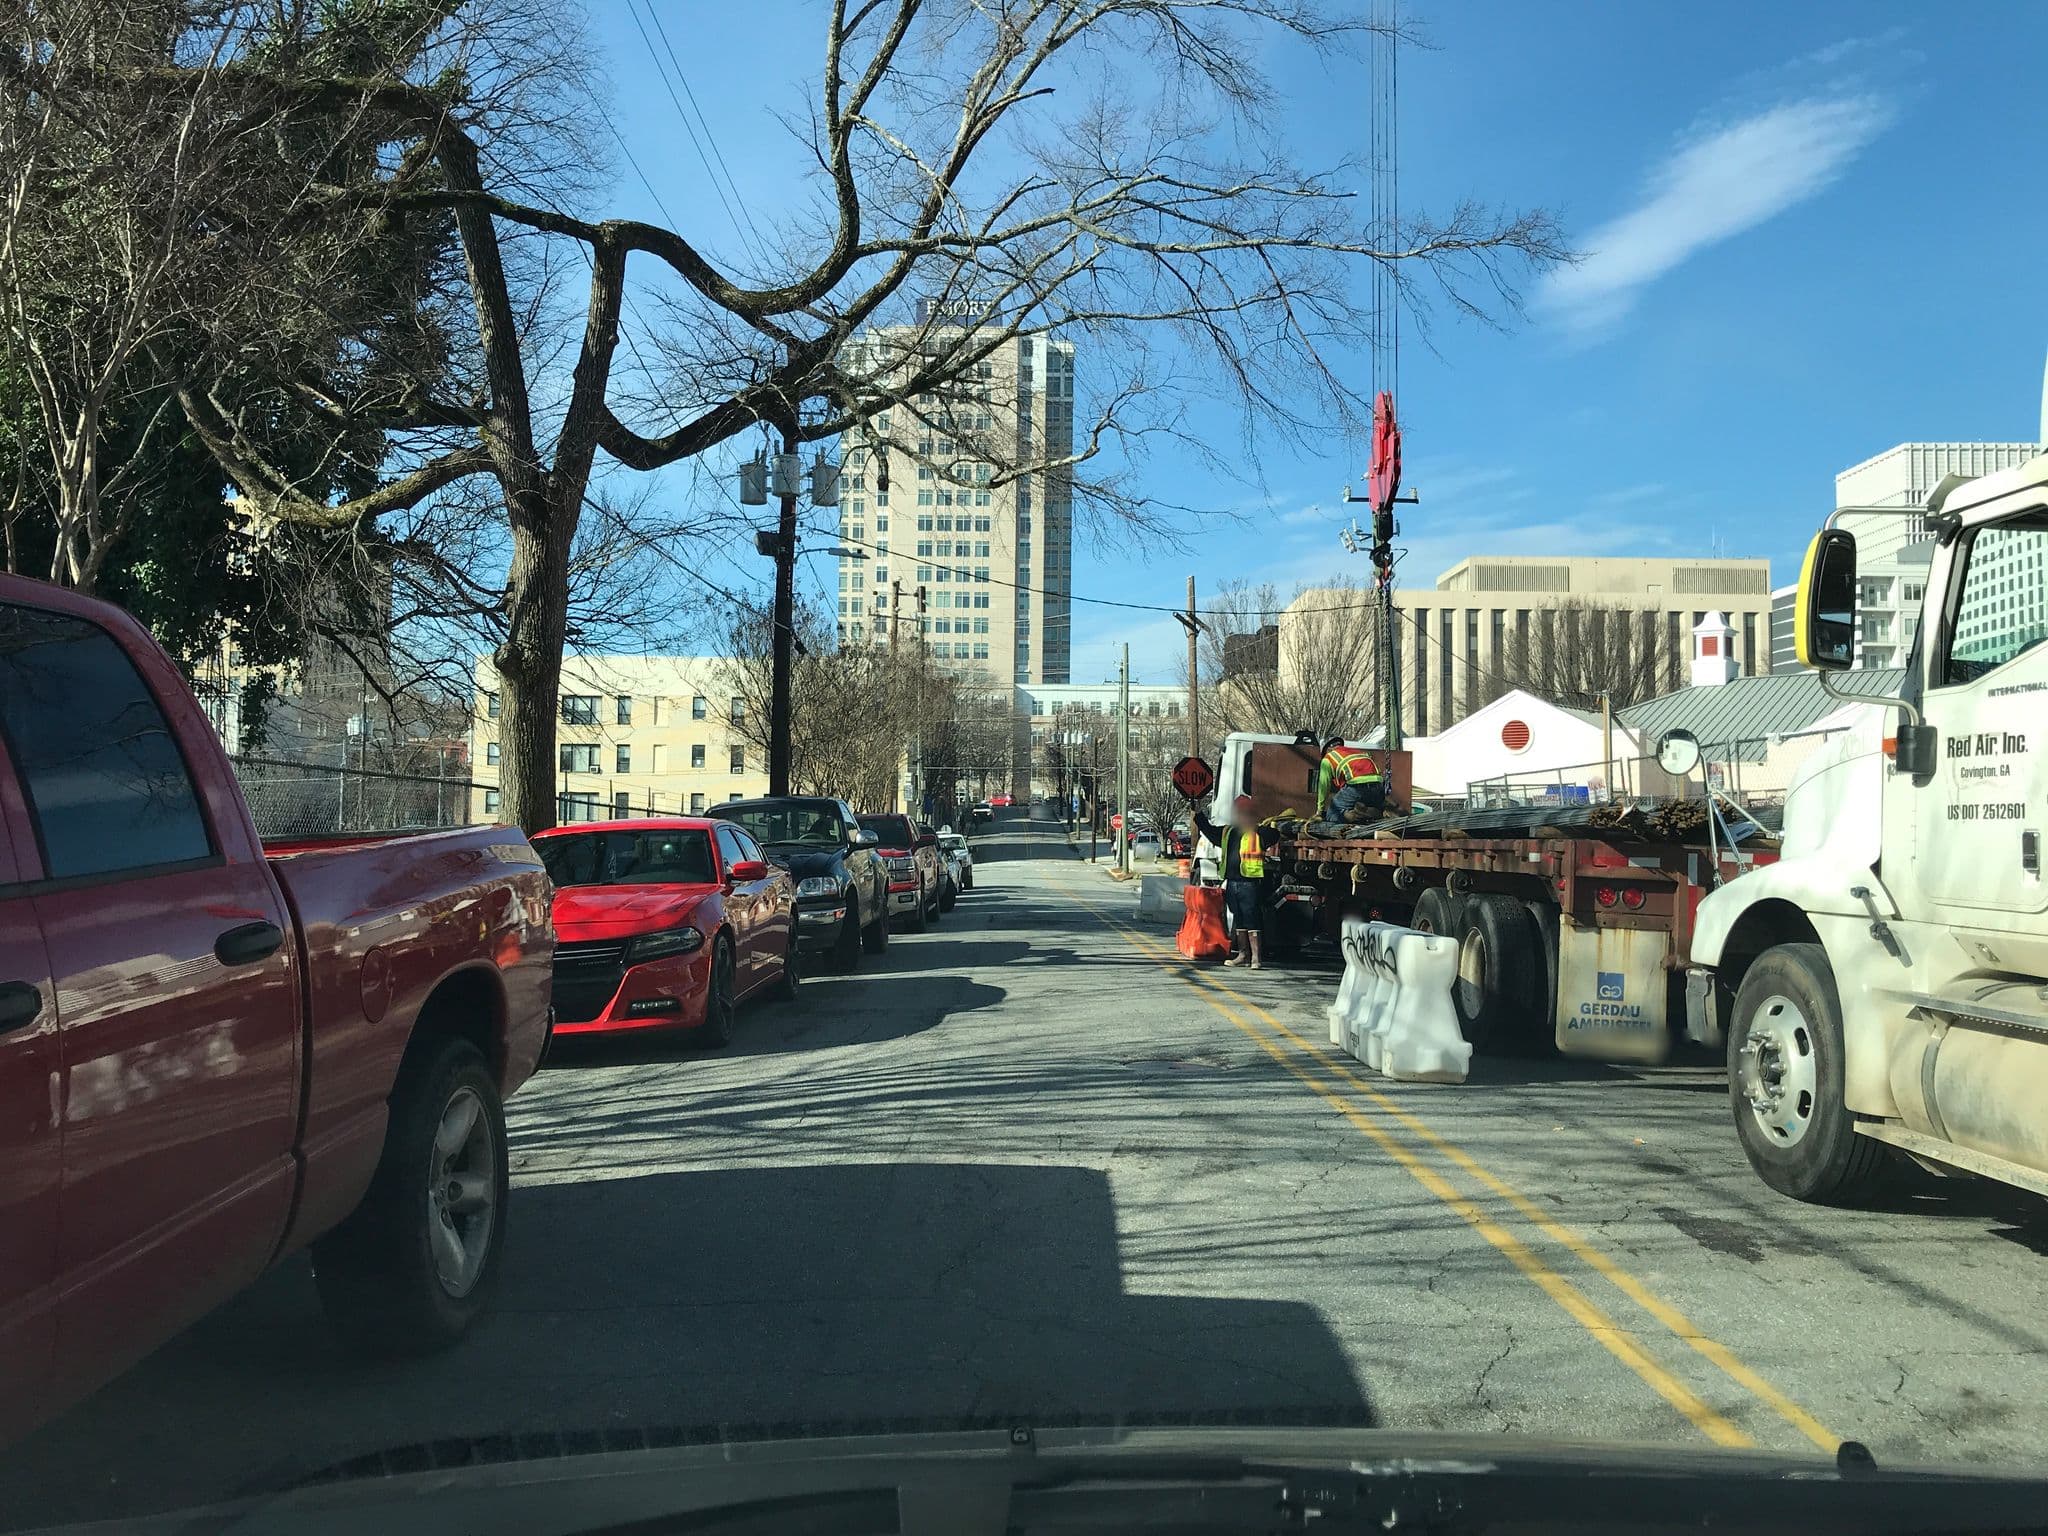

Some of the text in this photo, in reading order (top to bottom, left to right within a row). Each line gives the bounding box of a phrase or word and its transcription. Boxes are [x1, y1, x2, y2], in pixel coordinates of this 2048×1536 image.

[1947, 735, 1971, 759] Red
[2002, 732, 2028, 754] Inc.
[1178, 770, 1207, 786] SLOW
[1999, 764, 2010, 776] GA
[1947, 803, 2025, 820] US DOT 2512601
[1580, 1003, 1640, 1018] GERDAU
